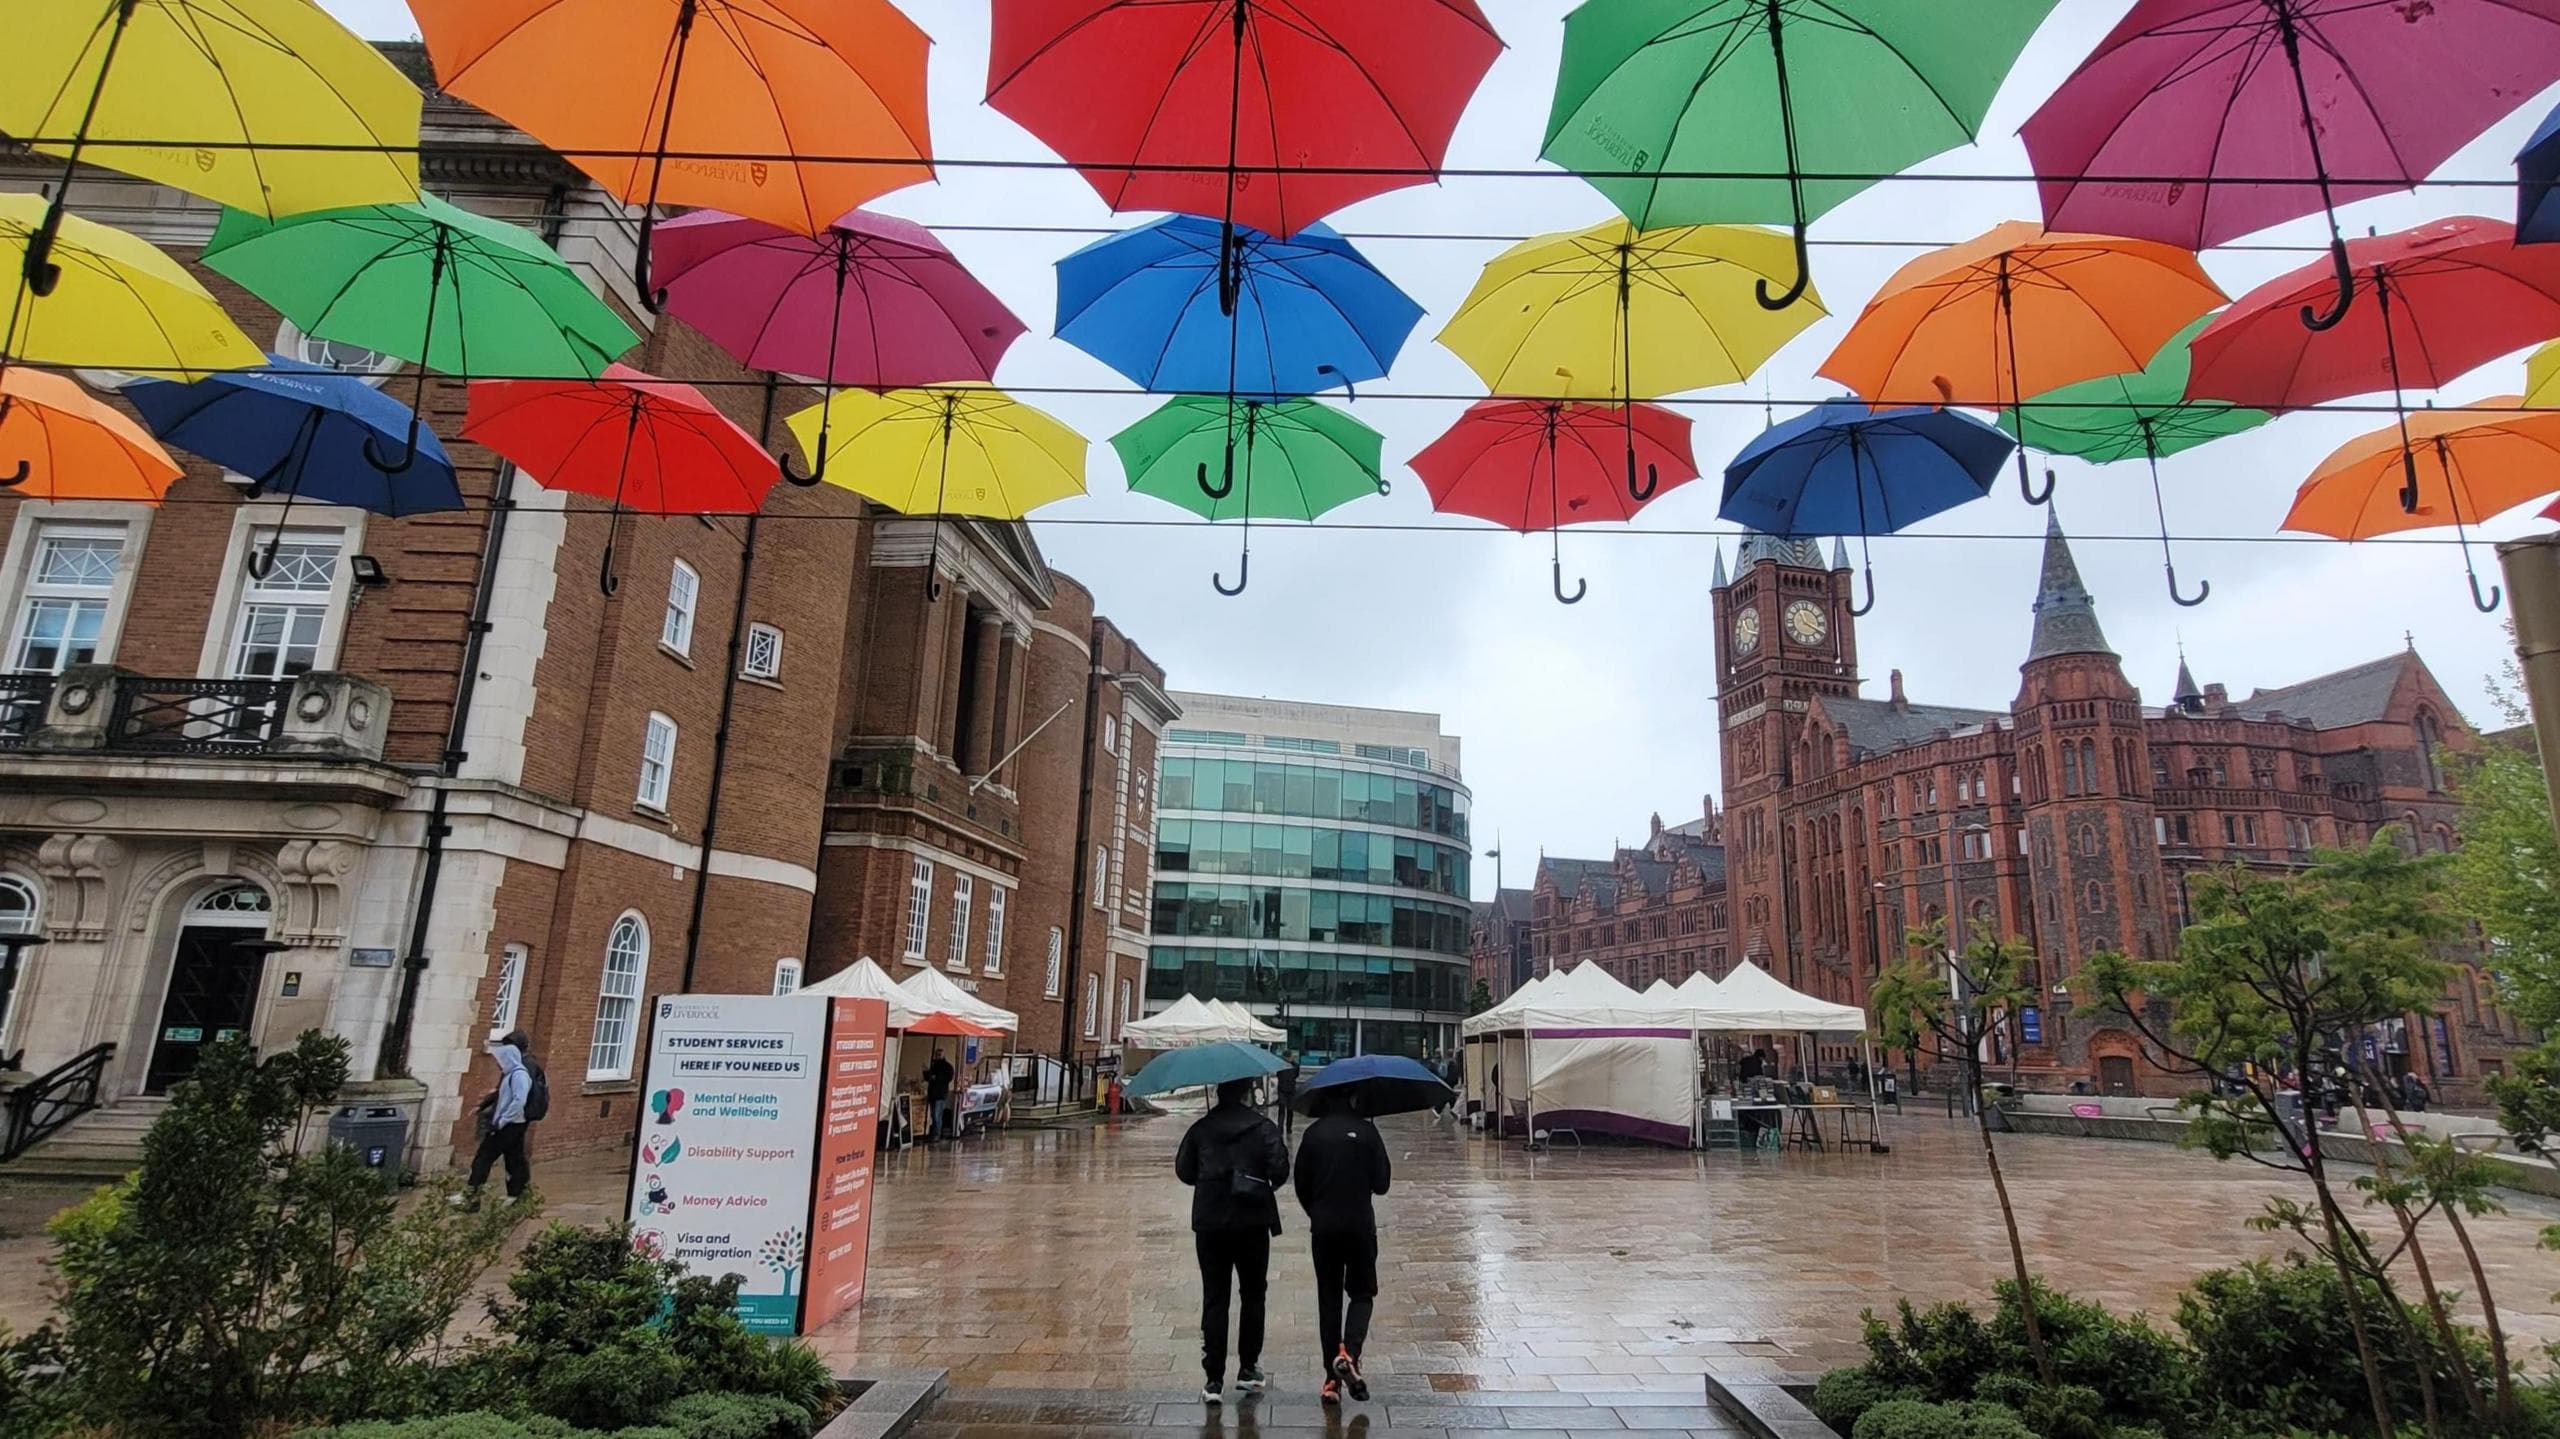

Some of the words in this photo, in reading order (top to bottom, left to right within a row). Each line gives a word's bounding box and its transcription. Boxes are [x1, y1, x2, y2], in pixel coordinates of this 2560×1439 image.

[668, 1037, 724, 1048] STUDENT
[726, 1038, 784, 1050] SERVICES
[680, 1060, 710, 1071] HERE
[712, 1060, 723, 1071] IF
[725, 1061, 751, 1072] YOU
[752, 1061, 783, 1072] NEED
[784, 1062, 800, 1072] US
[694, 1093, 736, 1103] Mental
[739, 1093, 778, 1104] Health
[692, 1106, 716, 1116] and
[719, 1106, 778, 1120] Wellbeing
[687, 1146, 744, 1160] Disability
[746, 1147, 795, 1162] Support
[682, 1195, 724, 1208] Money
[726, 1195, 768, 1207] Advice
[677, 1232, 703, 1244] Visa
[706, 1233, 731, 1244] and
[674, 1246, 752, 1261] Immigration
